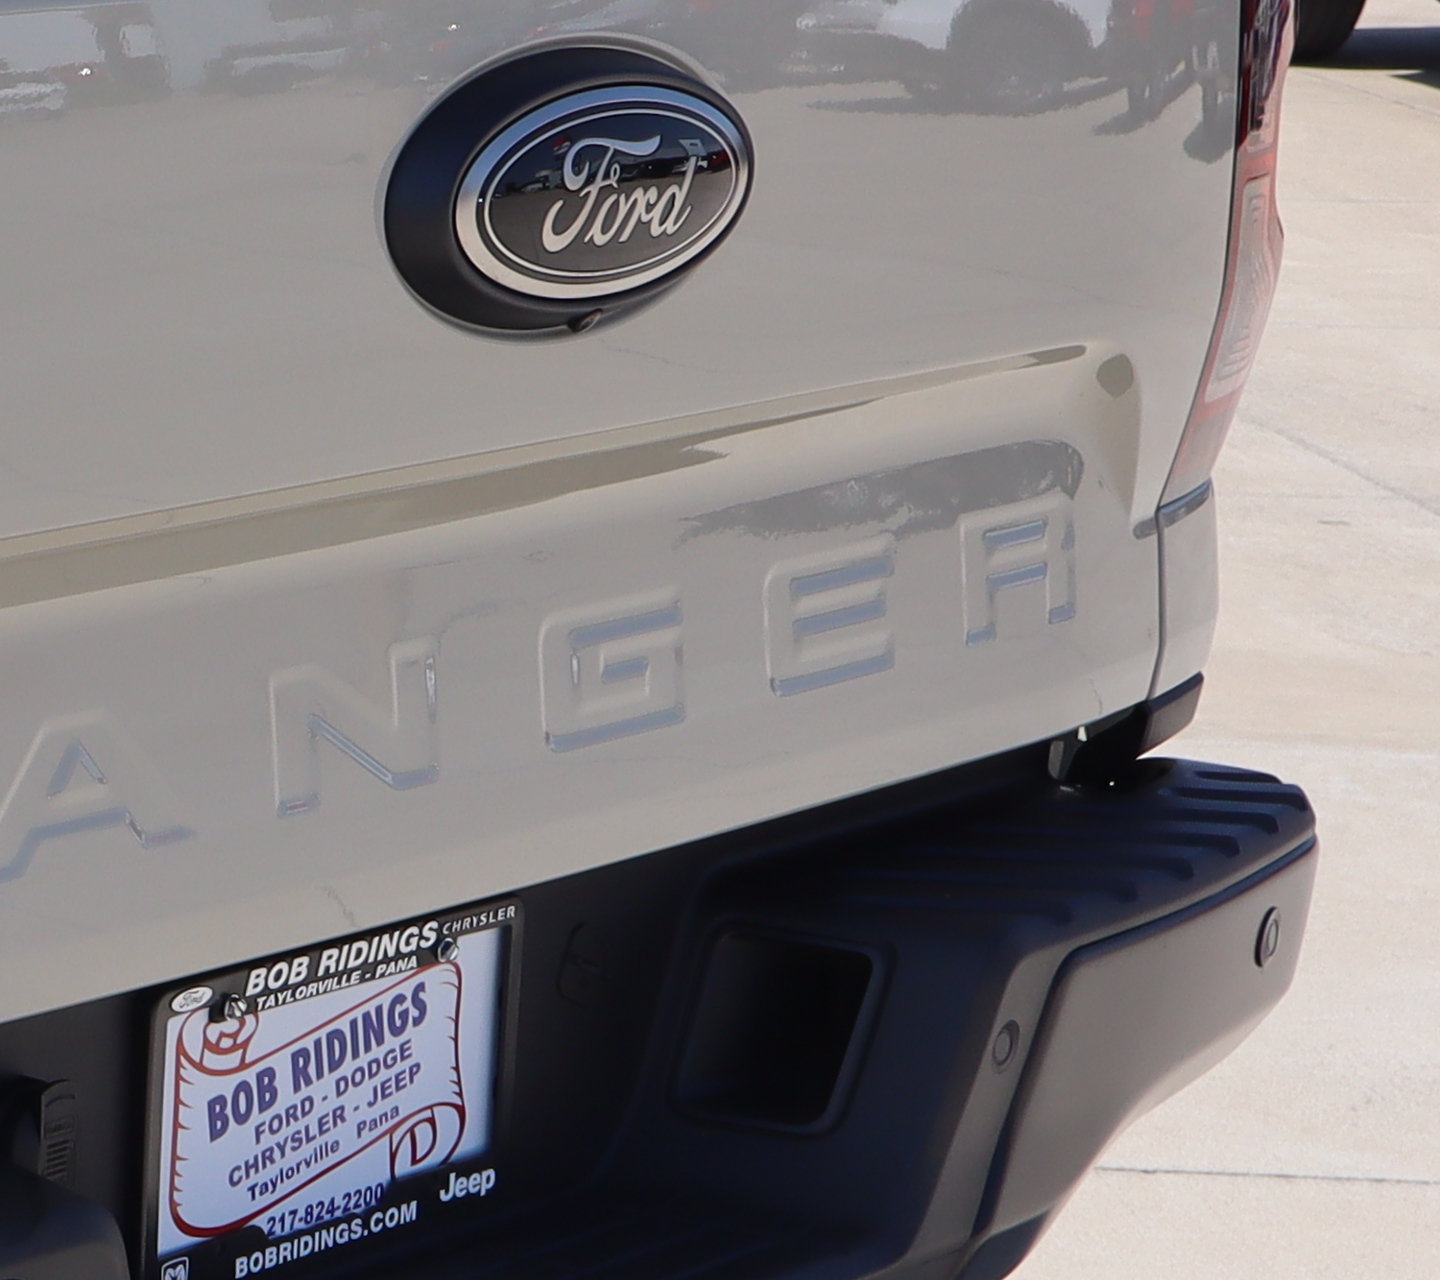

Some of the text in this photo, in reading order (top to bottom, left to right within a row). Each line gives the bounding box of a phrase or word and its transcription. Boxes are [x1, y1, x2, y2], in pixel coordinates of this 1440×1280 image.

[541, 134, 700, 254] Ford
[246, 905, 516, 996] BOB RIDINGS CHRYSLER
[256, 971, 360, 1011] TAYLORVILLE
[375, 956, 417, 978] PANA
[207, 981, 428, 1143] BOB RIDINGS
[254, 1094, 315, 1145] FORD
[334, 1038, 414, 1098] DODGE
[228, 1110, 347, 1188] CHRYSLER
[366, 1062, 423, 1109] JEEP
[247, 1104, 401, 1202] Taylorville Pana
[266, 1182, 385, 1237] 217-824-2200
[439, 1166, 496, 1204] Jeep
[235, 1200, 418, 1279] BOBRIDINGS.COM
